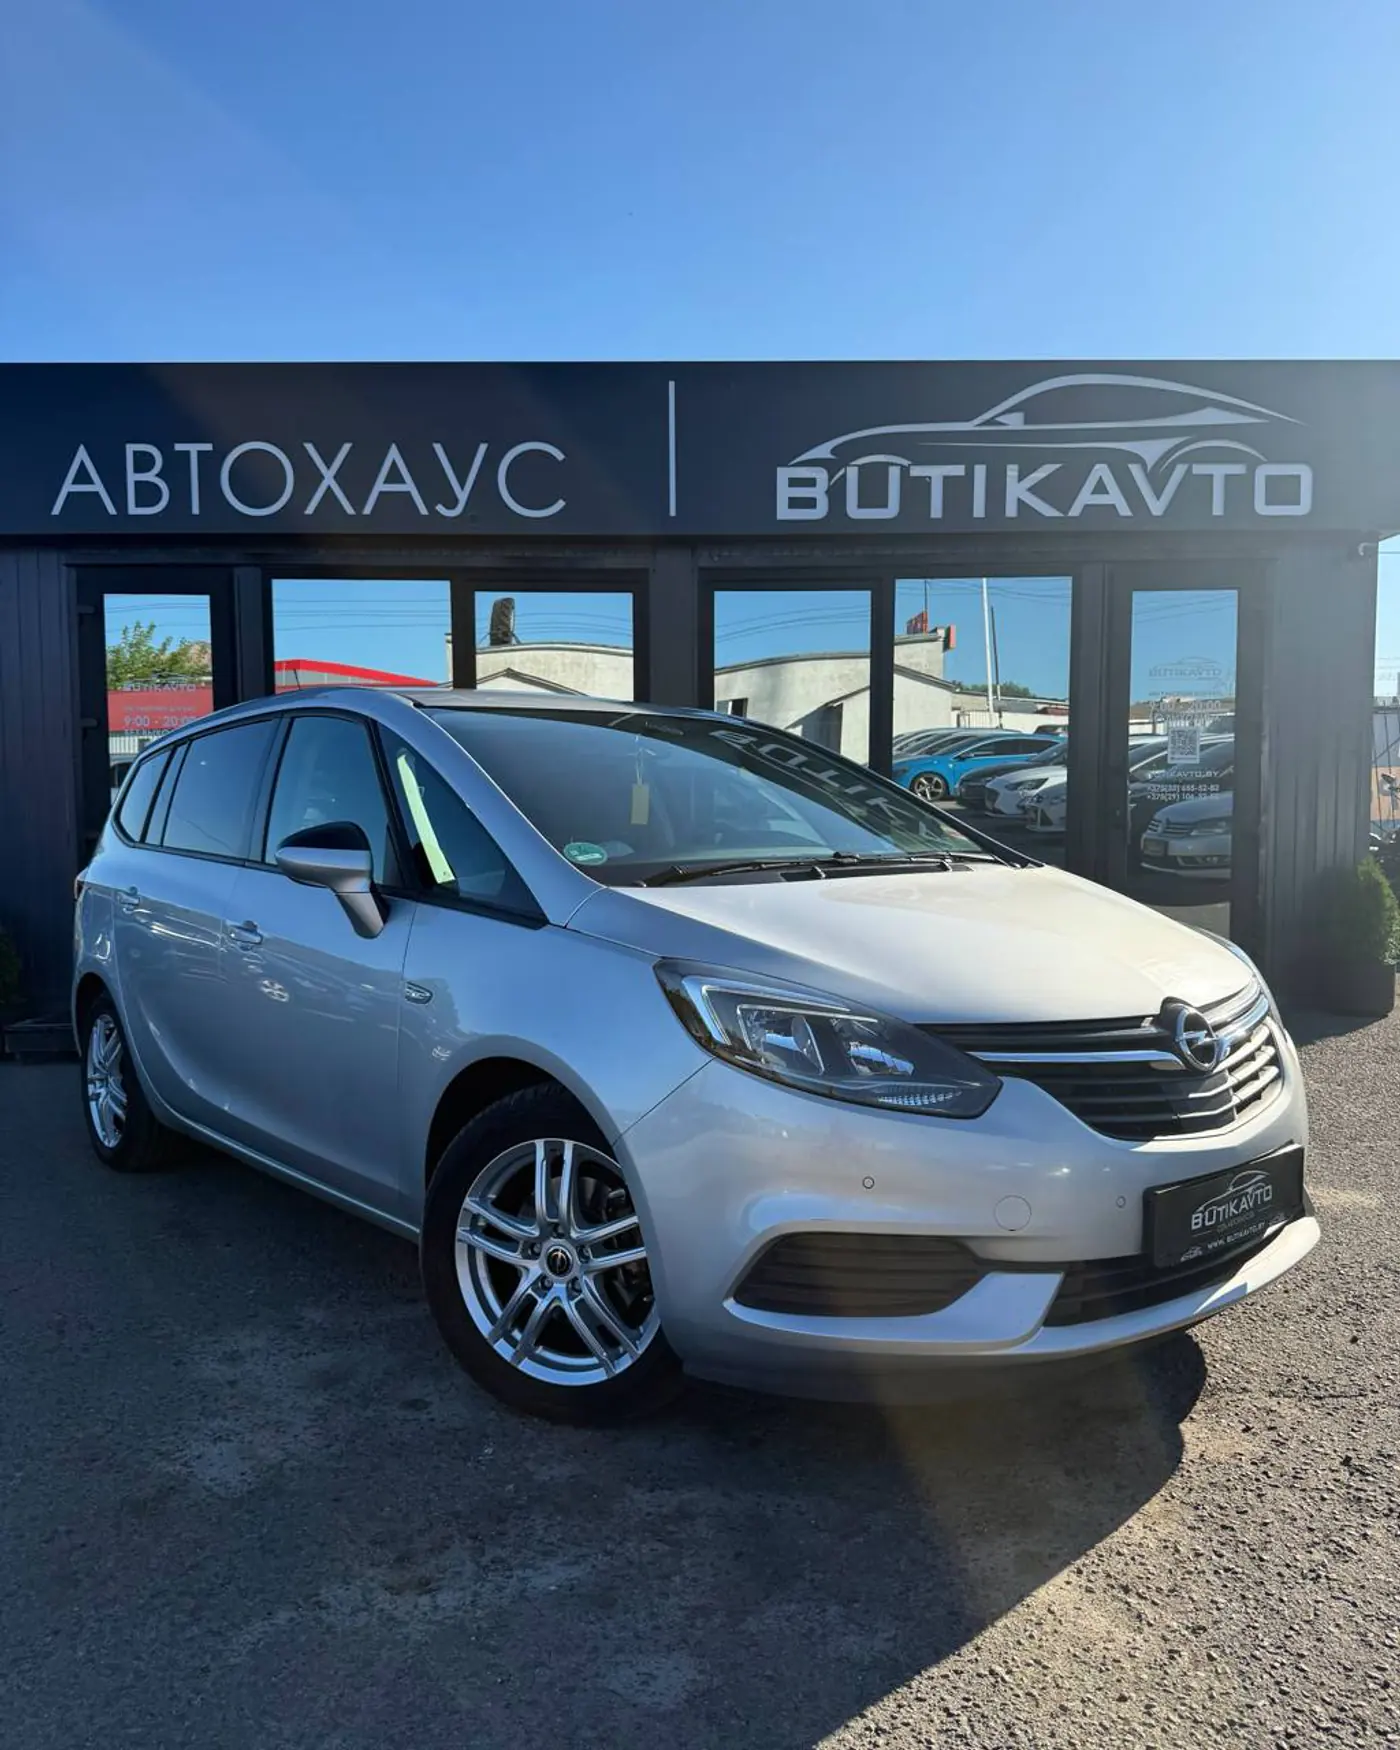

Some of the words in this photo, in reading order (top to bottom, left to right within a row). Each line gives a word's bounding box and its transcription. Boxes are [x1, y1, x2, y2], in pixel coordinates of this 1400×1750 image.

[51, 441, 566, 517] АВТОХАУС
[776, 462, 1313, 521] BUTIKAVTO
[1191, 1185, 1273, 1230] BUTIKAVTO
